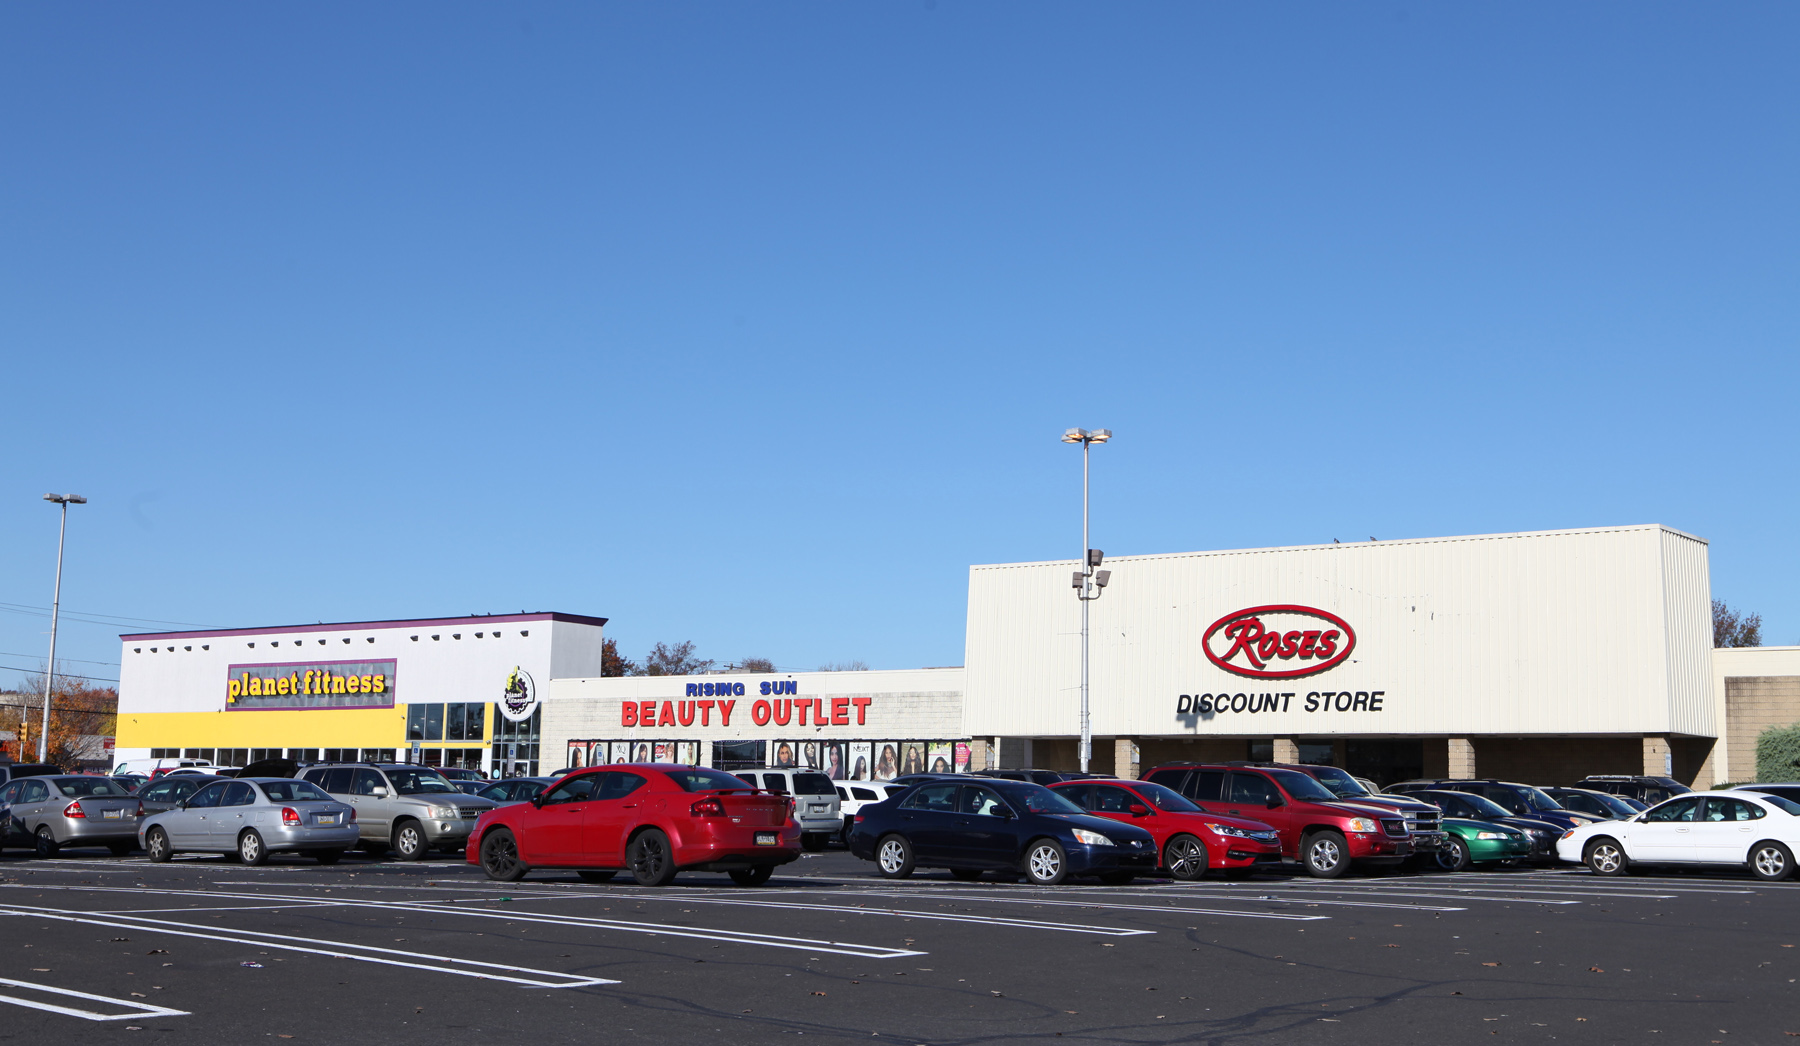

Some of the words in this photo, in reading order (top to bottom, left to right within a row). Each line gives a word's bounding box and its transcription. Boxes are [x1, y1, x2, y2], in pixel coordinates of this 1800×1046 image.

[1220, 616, 1340, 670] ROSES
[227, 671, 298, 703] planet
[303, 669, 386, 695] fitness
[686, 682, 745, 696] RISING
[760, 680, 797, 695] SUN
[621, 699, 736, 727] BEAUTY
[751, 697, 872, 727] OUTLET
[1177, 693, 1295, 713] DISCOUNT
[1304, 691, 1385, 712] STORE
